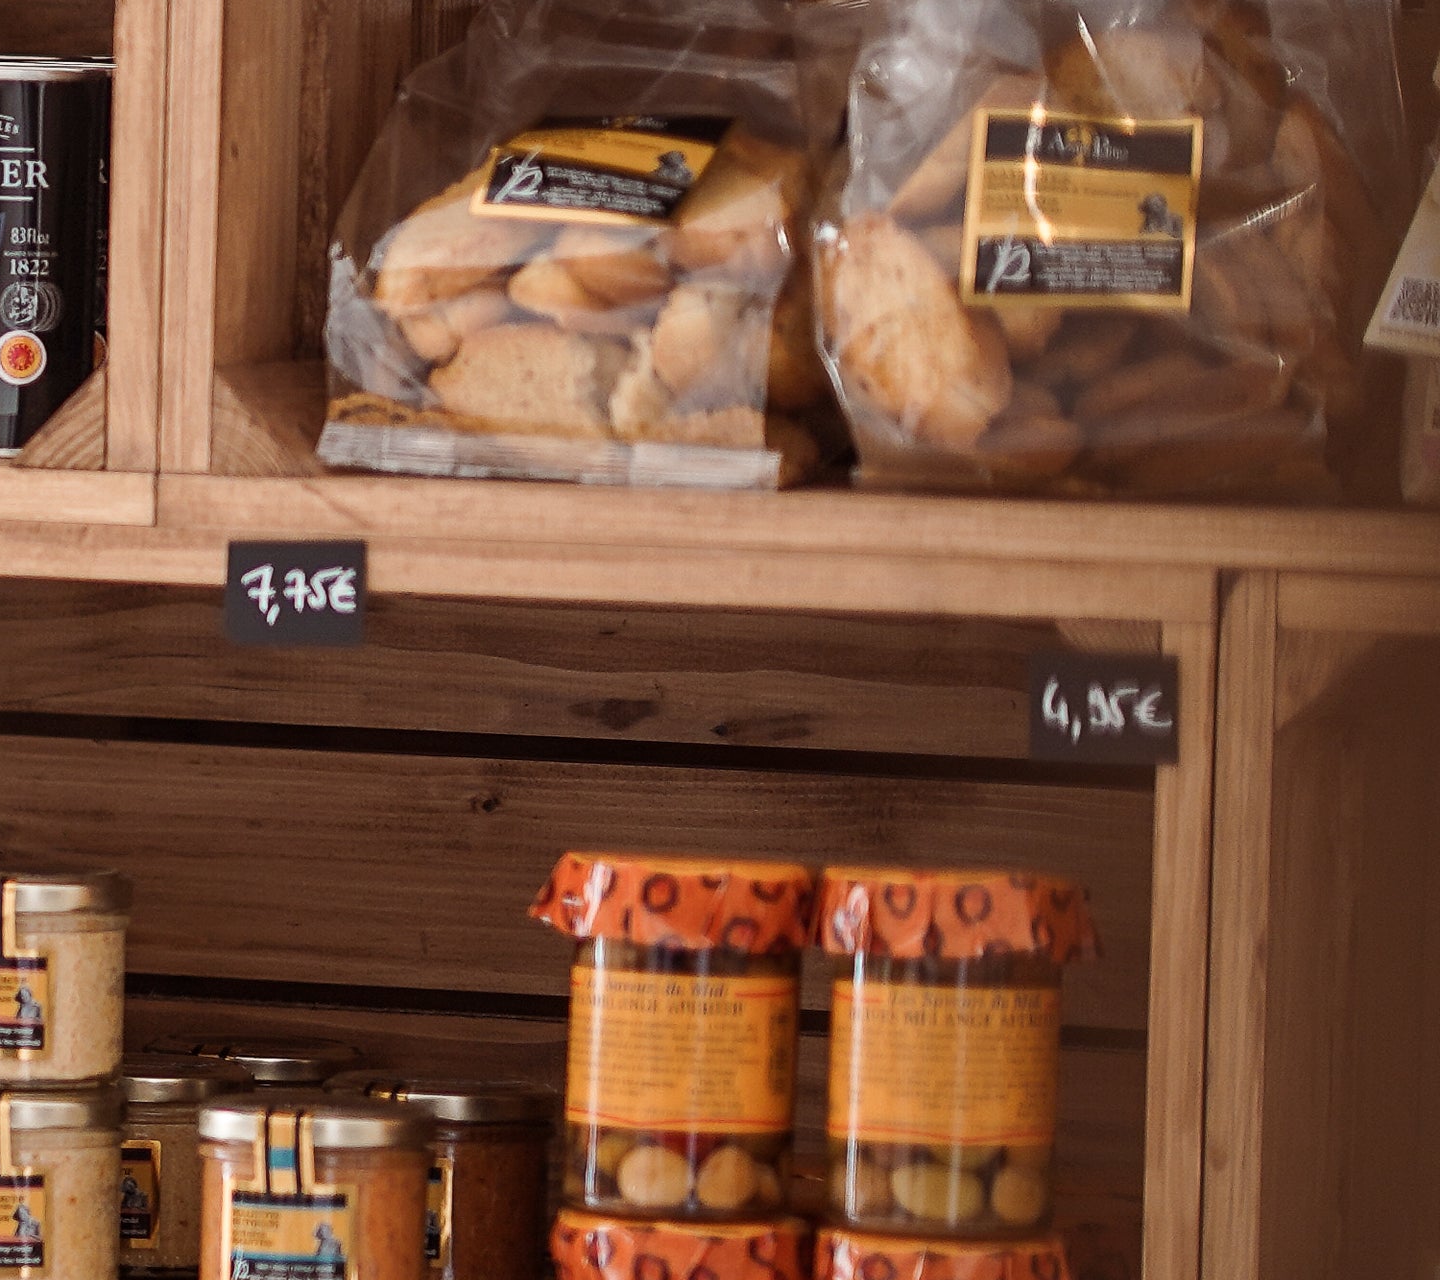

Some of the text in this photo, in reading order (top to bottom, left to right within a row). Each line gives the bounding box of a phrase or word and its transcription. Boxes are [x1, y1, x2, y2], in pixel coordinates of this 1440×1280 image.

[9, 258, 50, 277] 1822
[241, 565, 357, 626] 7,75€
[1042, 680, 1174, 745] 4,95€
